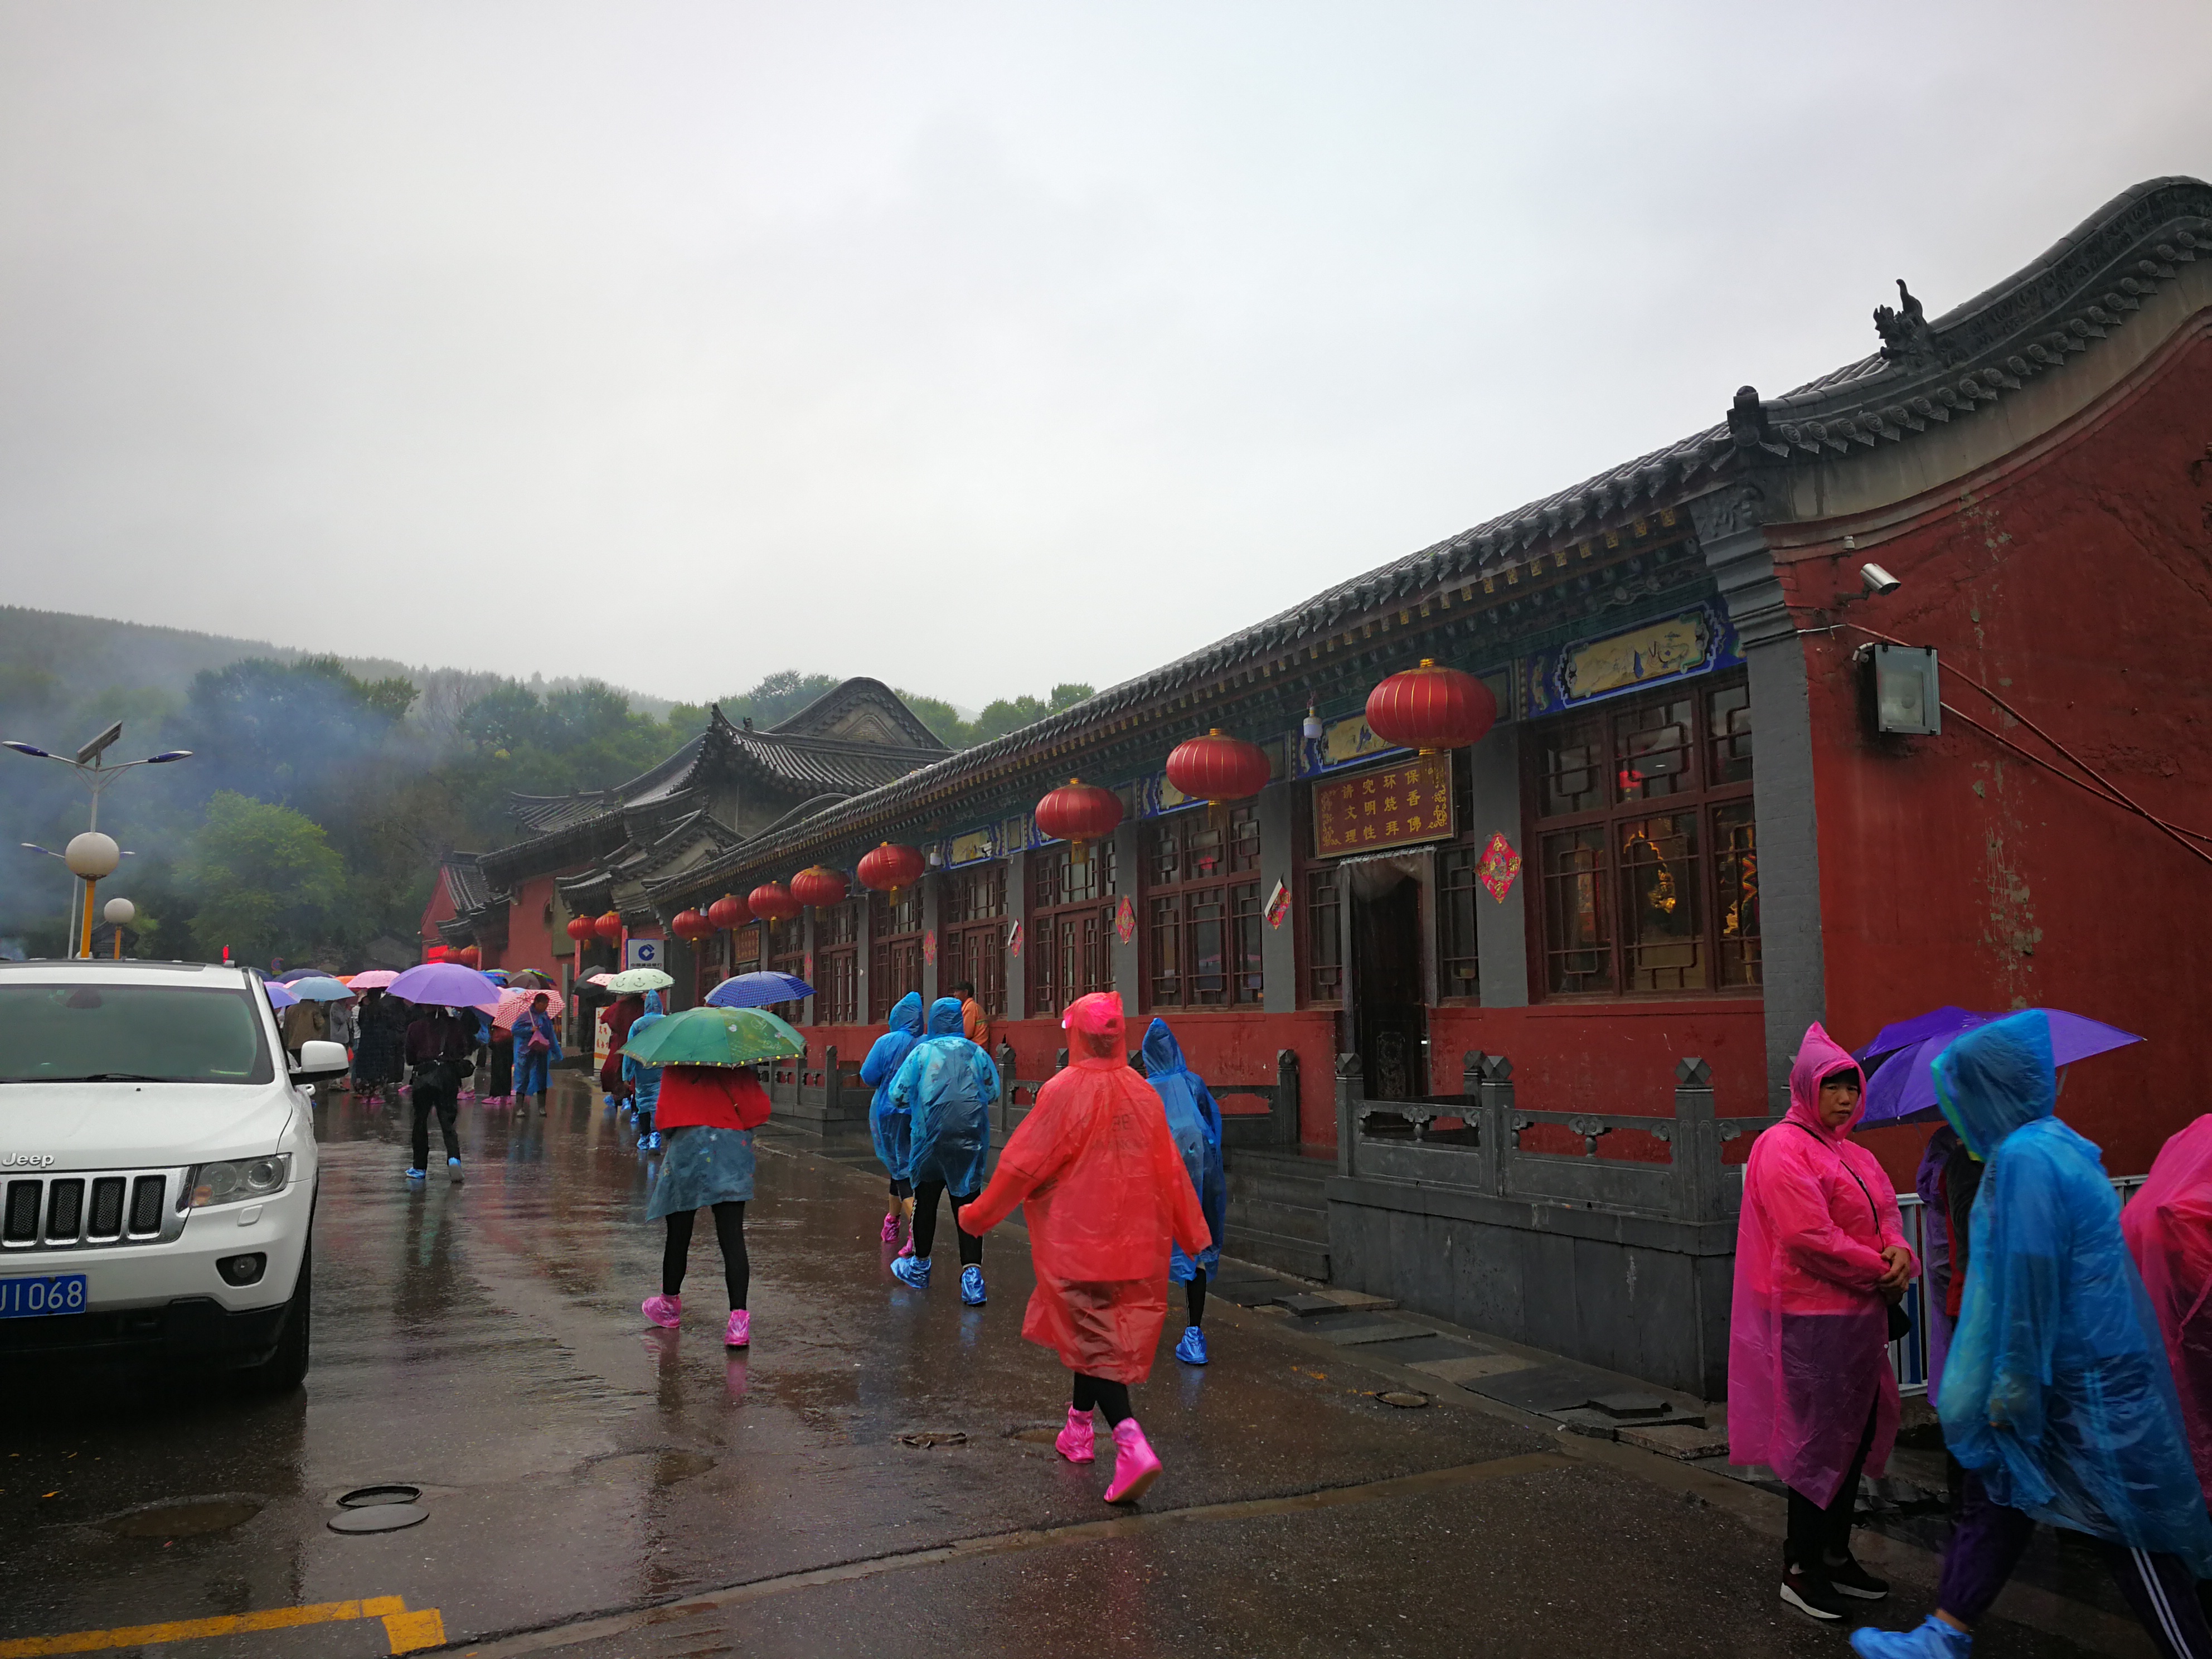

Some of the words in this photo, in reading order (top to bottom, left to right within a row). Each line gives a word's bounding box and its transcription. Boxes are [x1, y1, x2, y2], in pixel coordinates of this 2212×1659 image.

[1341, 769, 1419, 799] 讲究环保
[1344, 789, 1422, 820] 文明烧香
[1345, 816, 1422, 843] 理性拜佛
[2, 1153, 55, 1167] Jeep
